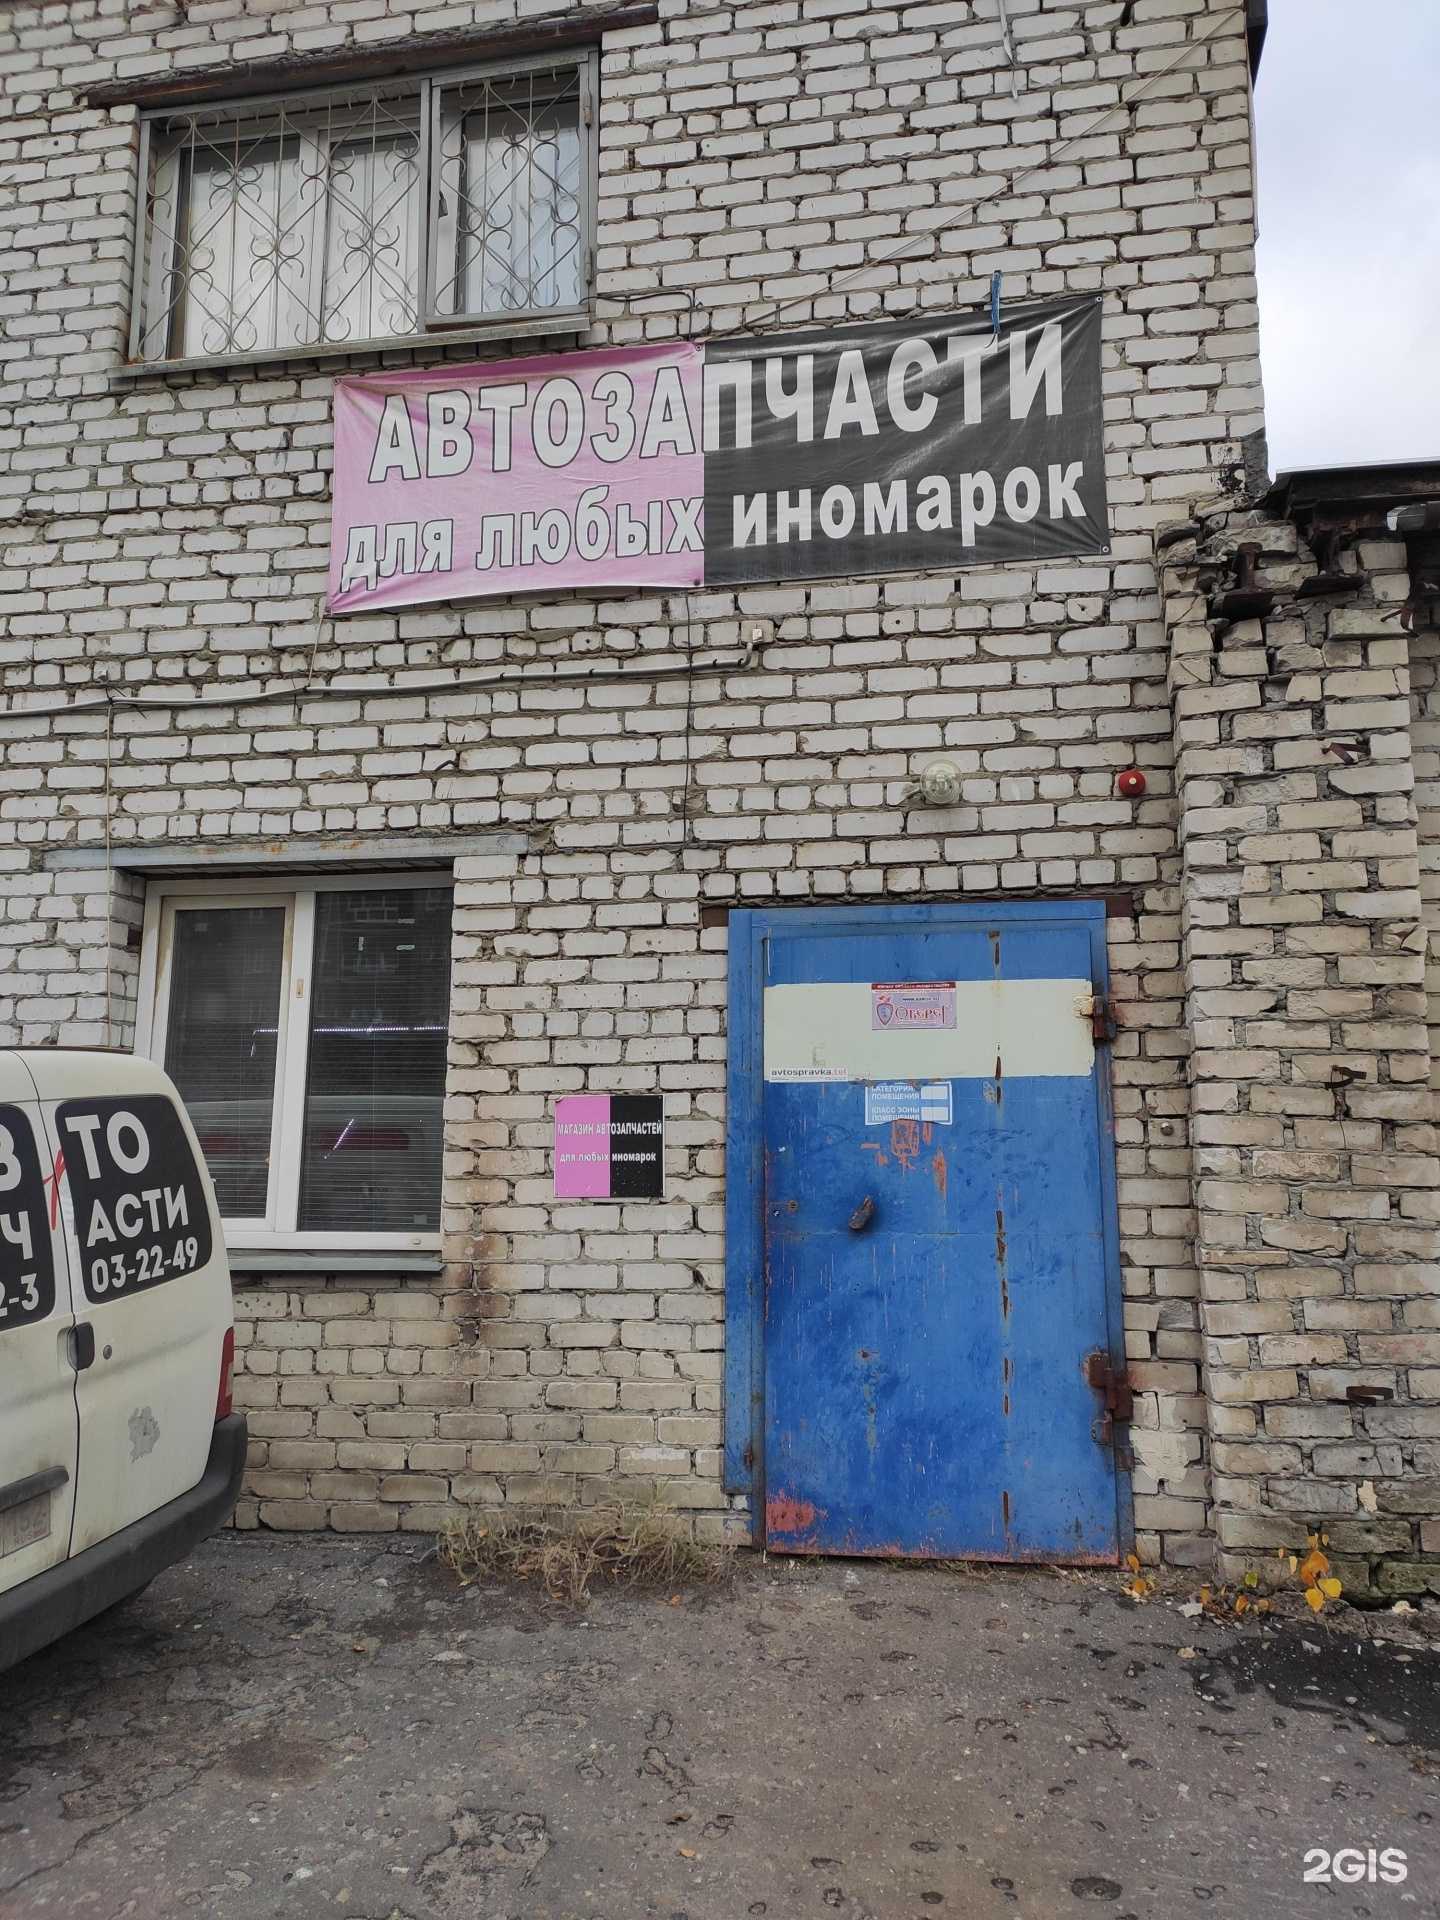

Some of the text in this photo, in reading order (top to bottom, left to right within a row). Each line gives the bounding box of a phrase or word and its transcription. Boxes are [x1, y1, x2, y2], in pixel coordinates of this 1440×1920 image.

[368, 324, 1063, 483] АВТОЗАПЧАСТИ
[340, 461, 1087, 593] для любых иномарок
[65, 1111, 151, 1180] ТО
[557, 1119, 662, 1136] МАГАЗИН АВТОЗАПЧАСТЕЙ
[611, 1151, 657, 1164] иномарок
[86, 1184, 190, 1248] АСТИ
[91, 1236, 199, 1294] 03-22-49
